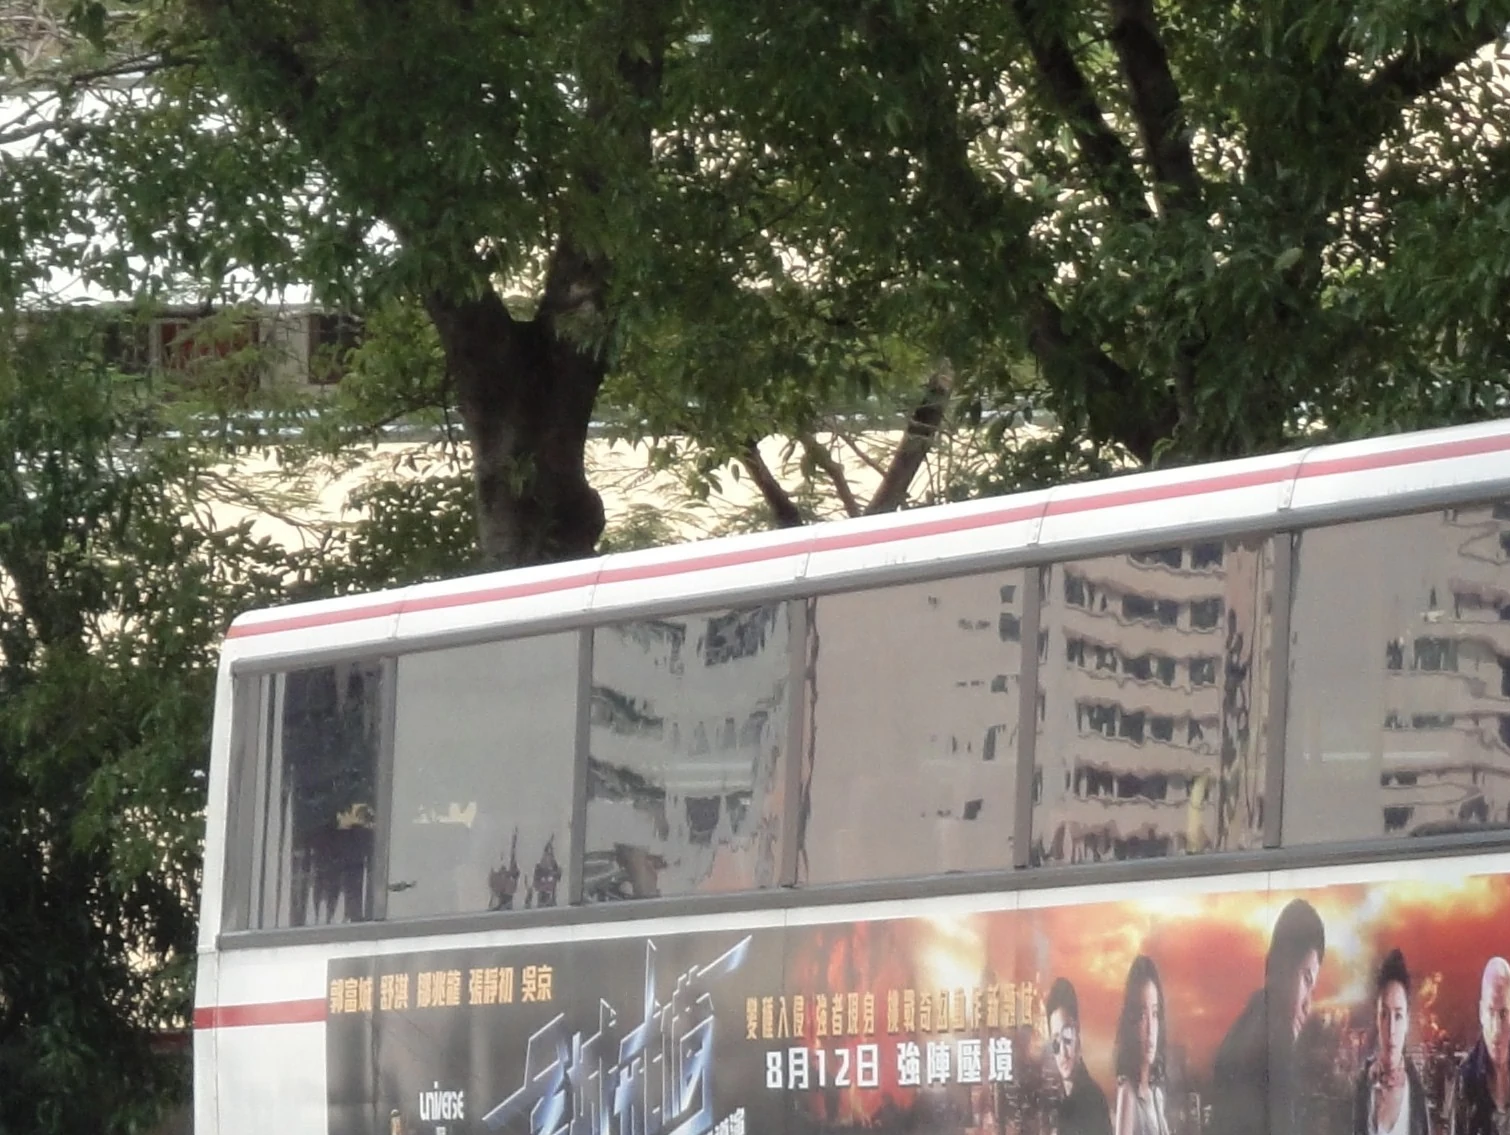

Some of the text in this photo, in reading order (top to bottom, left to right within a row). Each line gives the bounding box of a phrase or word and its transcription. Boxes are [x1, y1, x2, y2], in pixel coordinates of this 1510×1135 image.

[380, 973, 409, 1011] 舒淇
[521, 964, 554, 1003] 吳京
[766, 1037, 1014, 1089] 8月12日 強陣壓境
